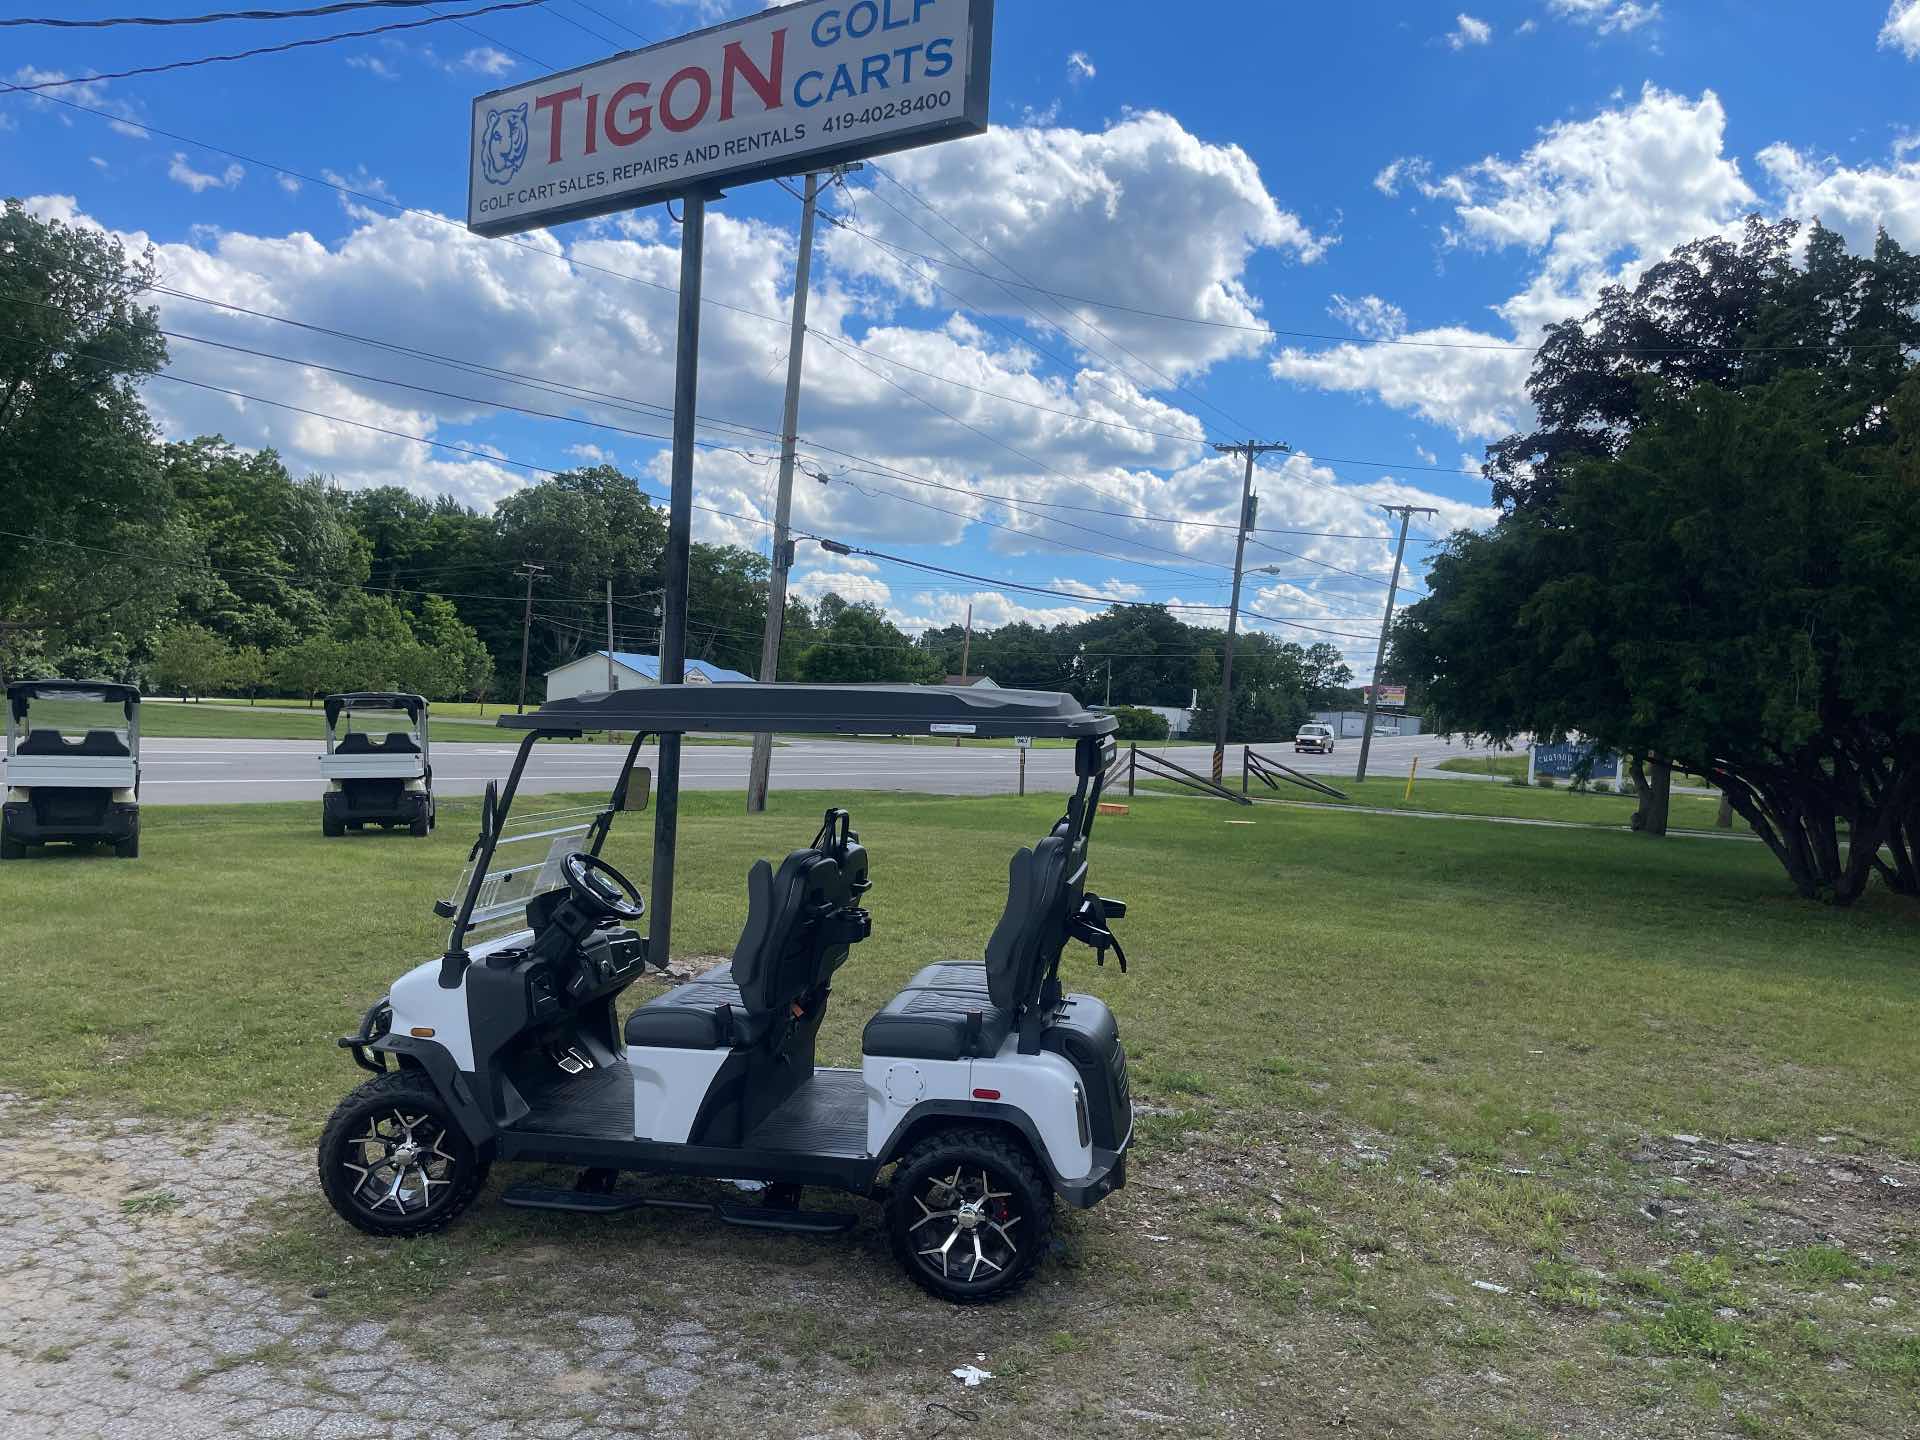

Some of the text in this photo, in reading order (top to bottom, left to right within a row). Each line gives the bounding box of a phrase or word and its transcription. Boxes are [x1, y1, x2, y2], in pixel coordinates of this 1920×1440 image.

[811, 0, 936, 47] GOLF
[535, 28, 788, 165] TIGON
[793, 38, 954, 108] CARTS
[822, 90, 951, 133] 419-402-8400
[479, 124, 806, 213] GOLF CART SALES, REPAIRS AND RENTALS
